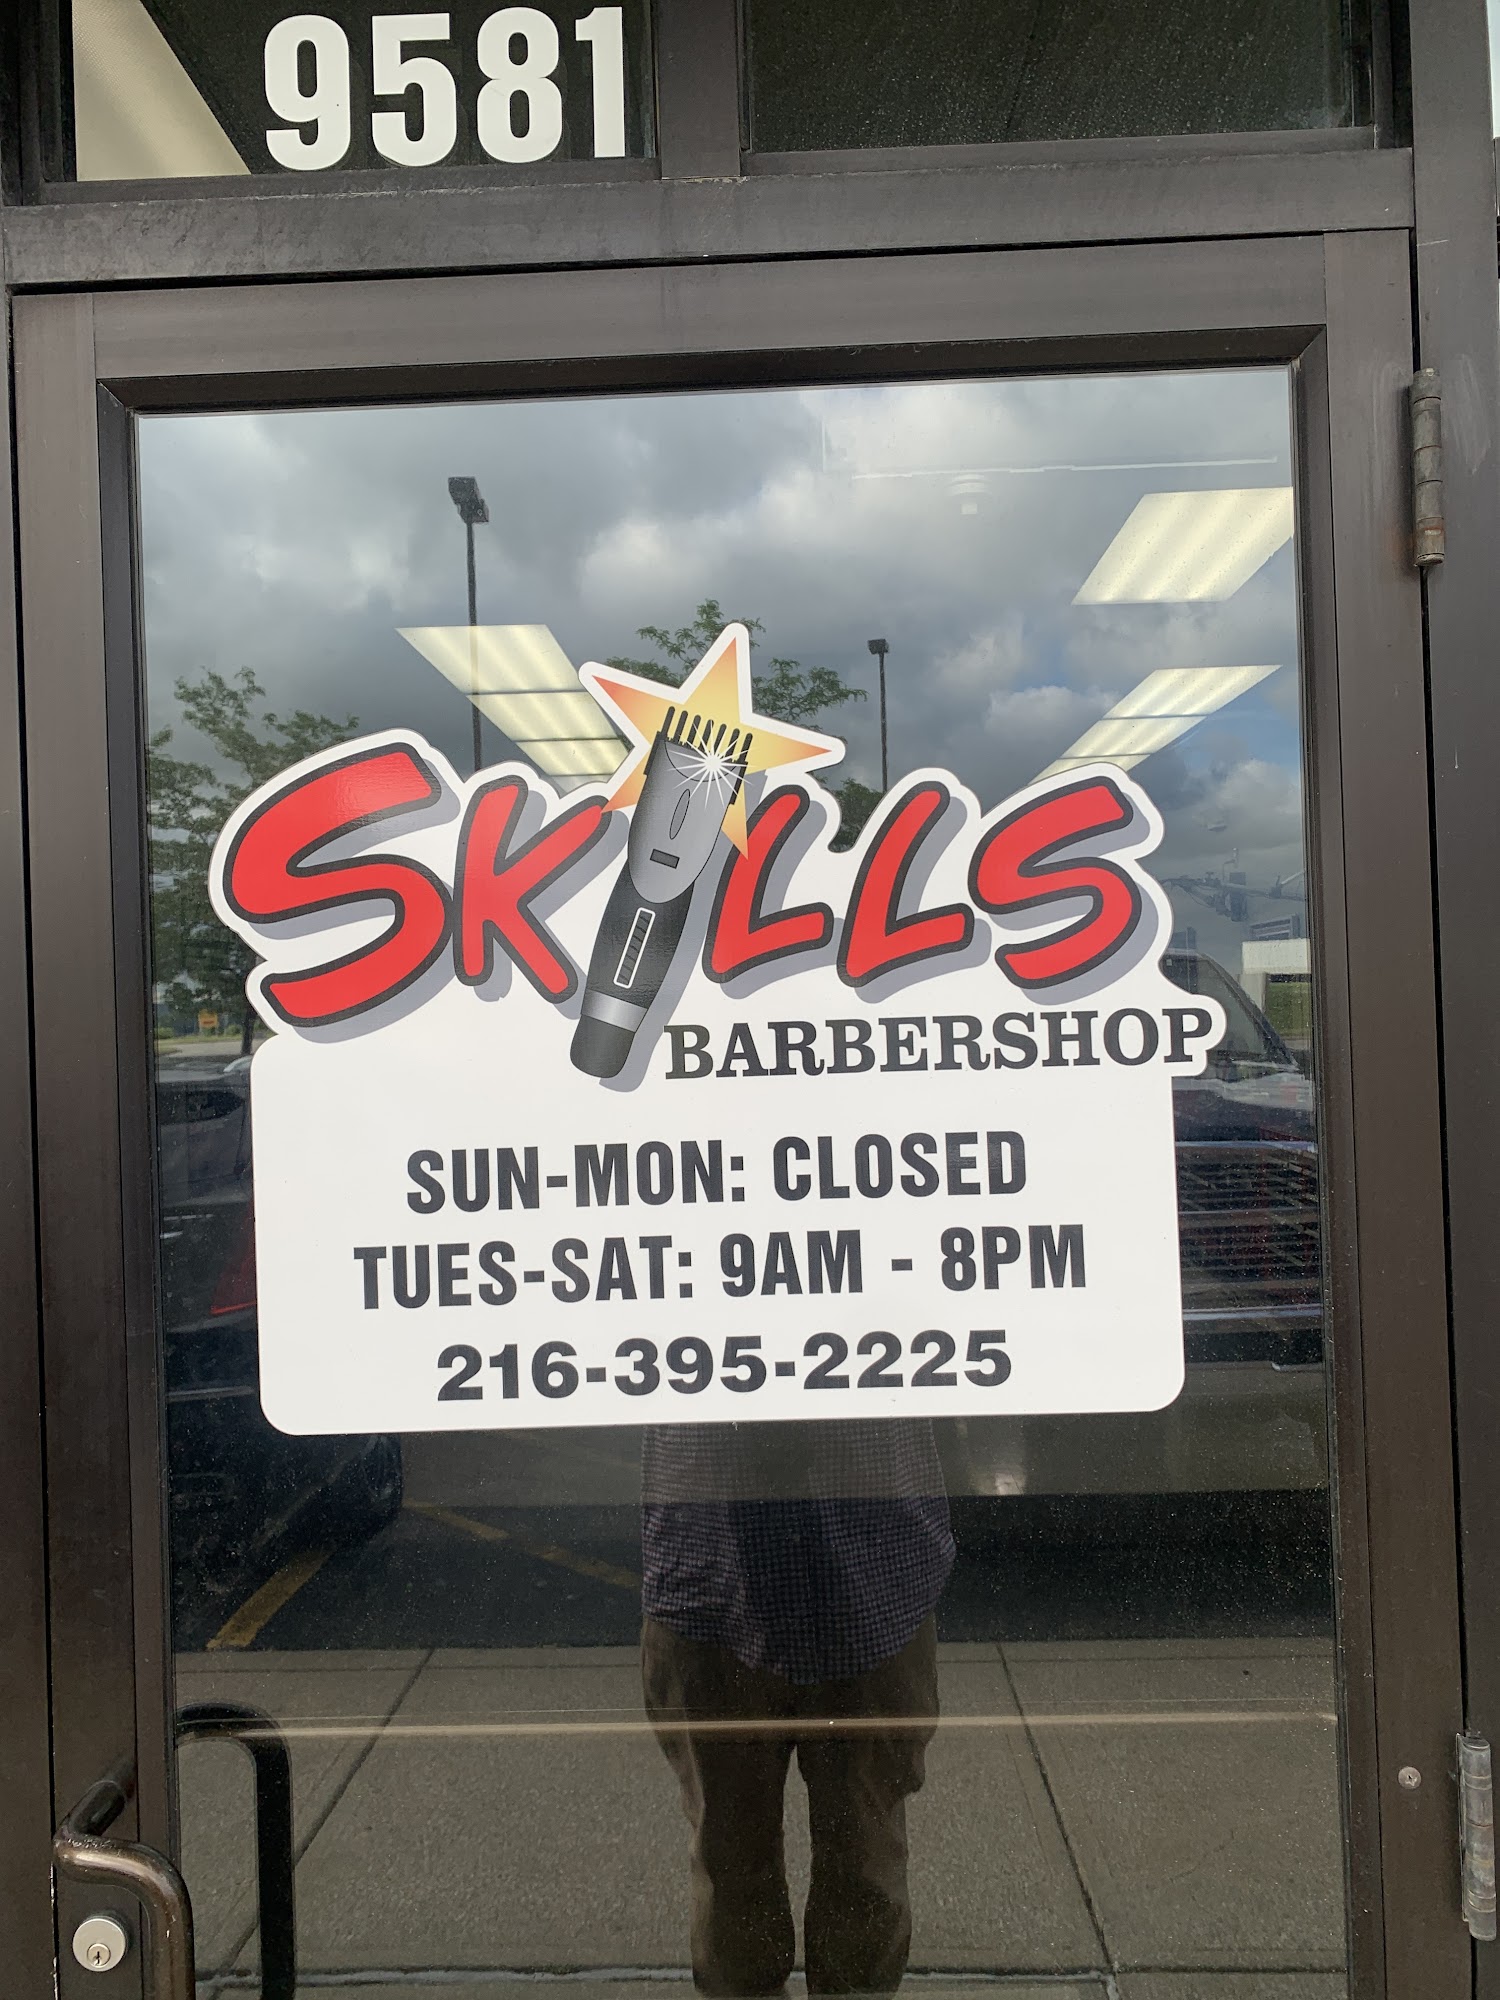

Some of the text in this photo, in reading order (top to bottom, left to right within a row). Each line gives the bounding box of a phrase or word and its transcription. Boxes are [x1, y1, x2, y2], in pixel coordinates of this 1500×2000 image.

[265, 7, 625, 170] 9581
[222, 706, 1147, 1080] SKILLS
[664, 1008, 1213, 1079] BARBERSHOP
[408, 1131, 1026, 1214] SUN-MON: CLOSED
[354, 1225, 1085, 1309] TUES-SAT: 9AM - 8PM
[438, 1330, 1011, 1401] 216-395-2225
